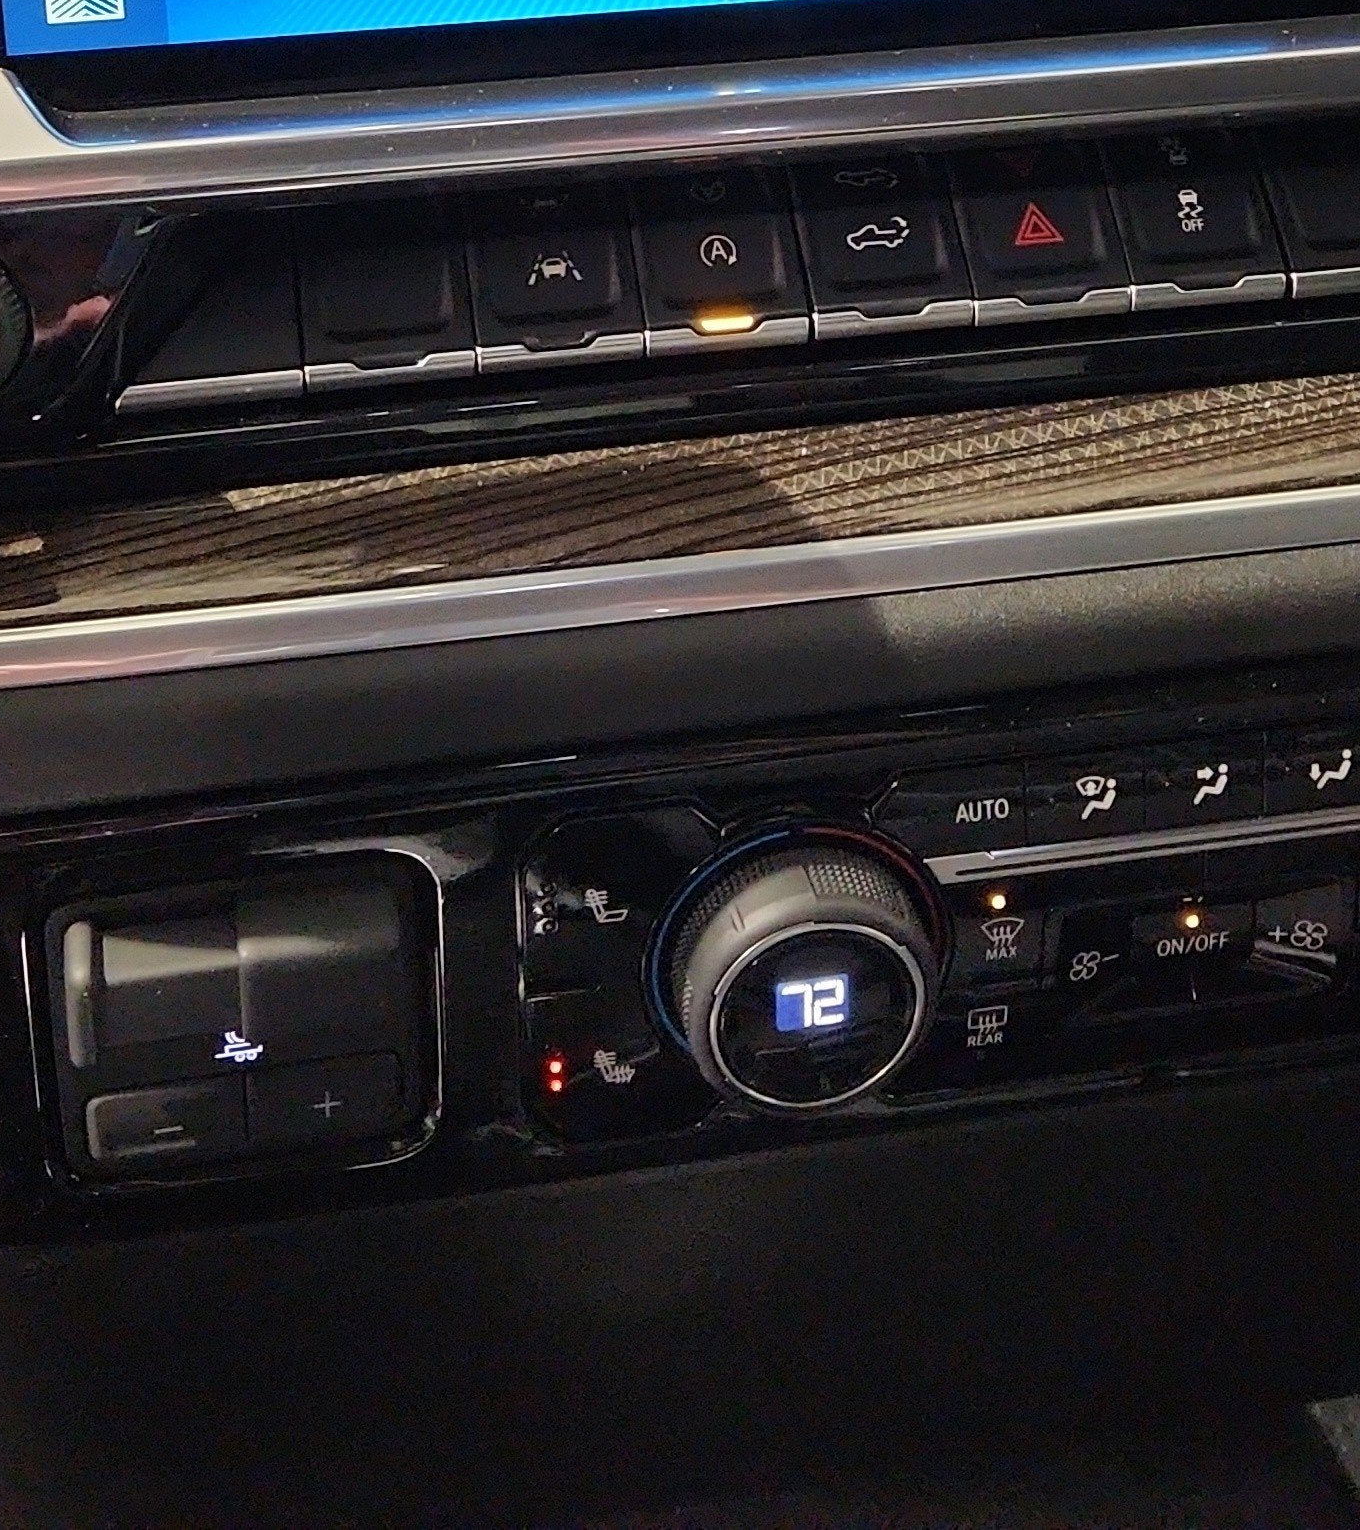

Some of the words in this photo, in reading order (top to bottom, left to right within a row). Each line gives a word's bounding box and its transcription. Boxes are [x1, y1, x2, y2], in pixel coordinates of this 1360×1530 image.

[1181, 218, 1205, 233] OFF
[955, 798, 1010, 824] AUTO
[985, 946, 1018, 961] MAX
[1156, 931, 1230, 958] ON/OFF
[781, 978, 845, 1029] 72
[966, 1032, 1003, 1047] REAR
